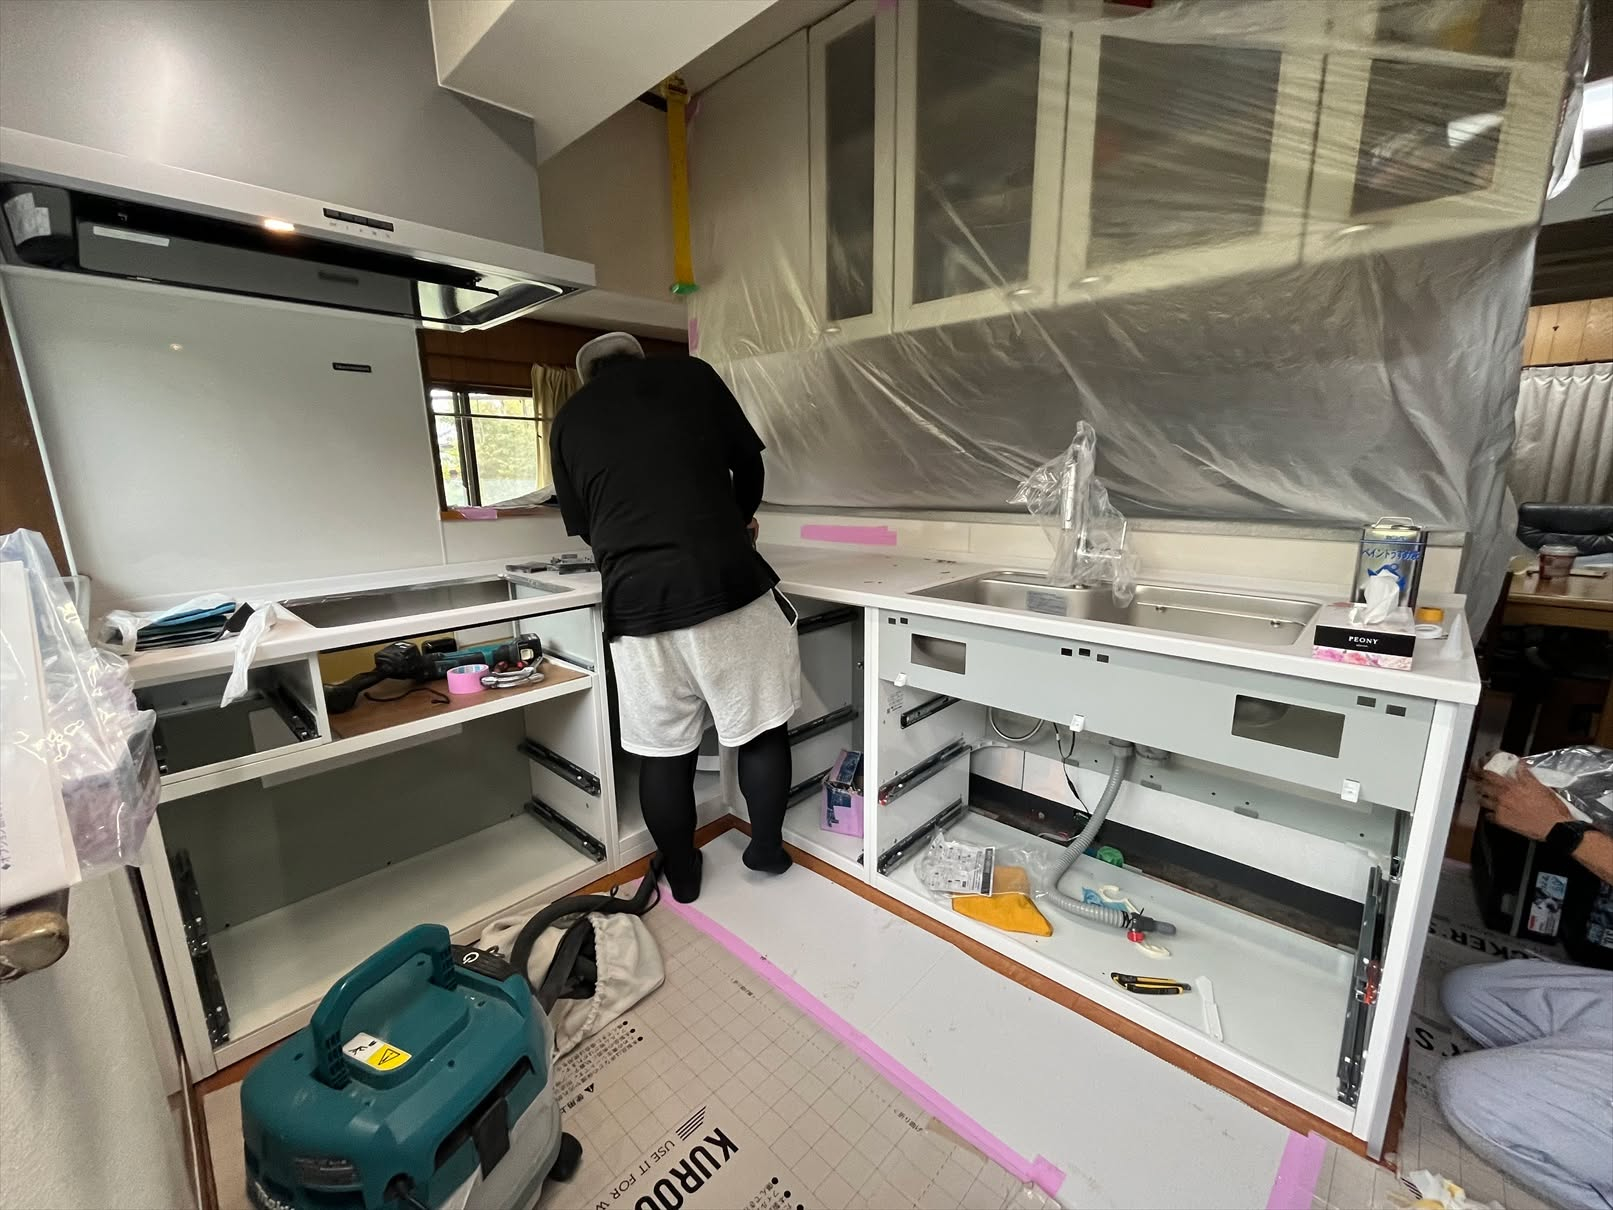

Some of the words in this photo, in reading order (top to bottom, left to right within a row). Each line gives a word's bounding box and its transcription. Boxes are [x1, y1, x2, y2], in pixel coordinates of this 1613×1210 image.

[1348, 635, 1379, 645] PEONY
[650, 1140, 676, 1163] USE
[638, 1160, 652, 1176] IT
[610, 1174, 637, 1200] FOR
